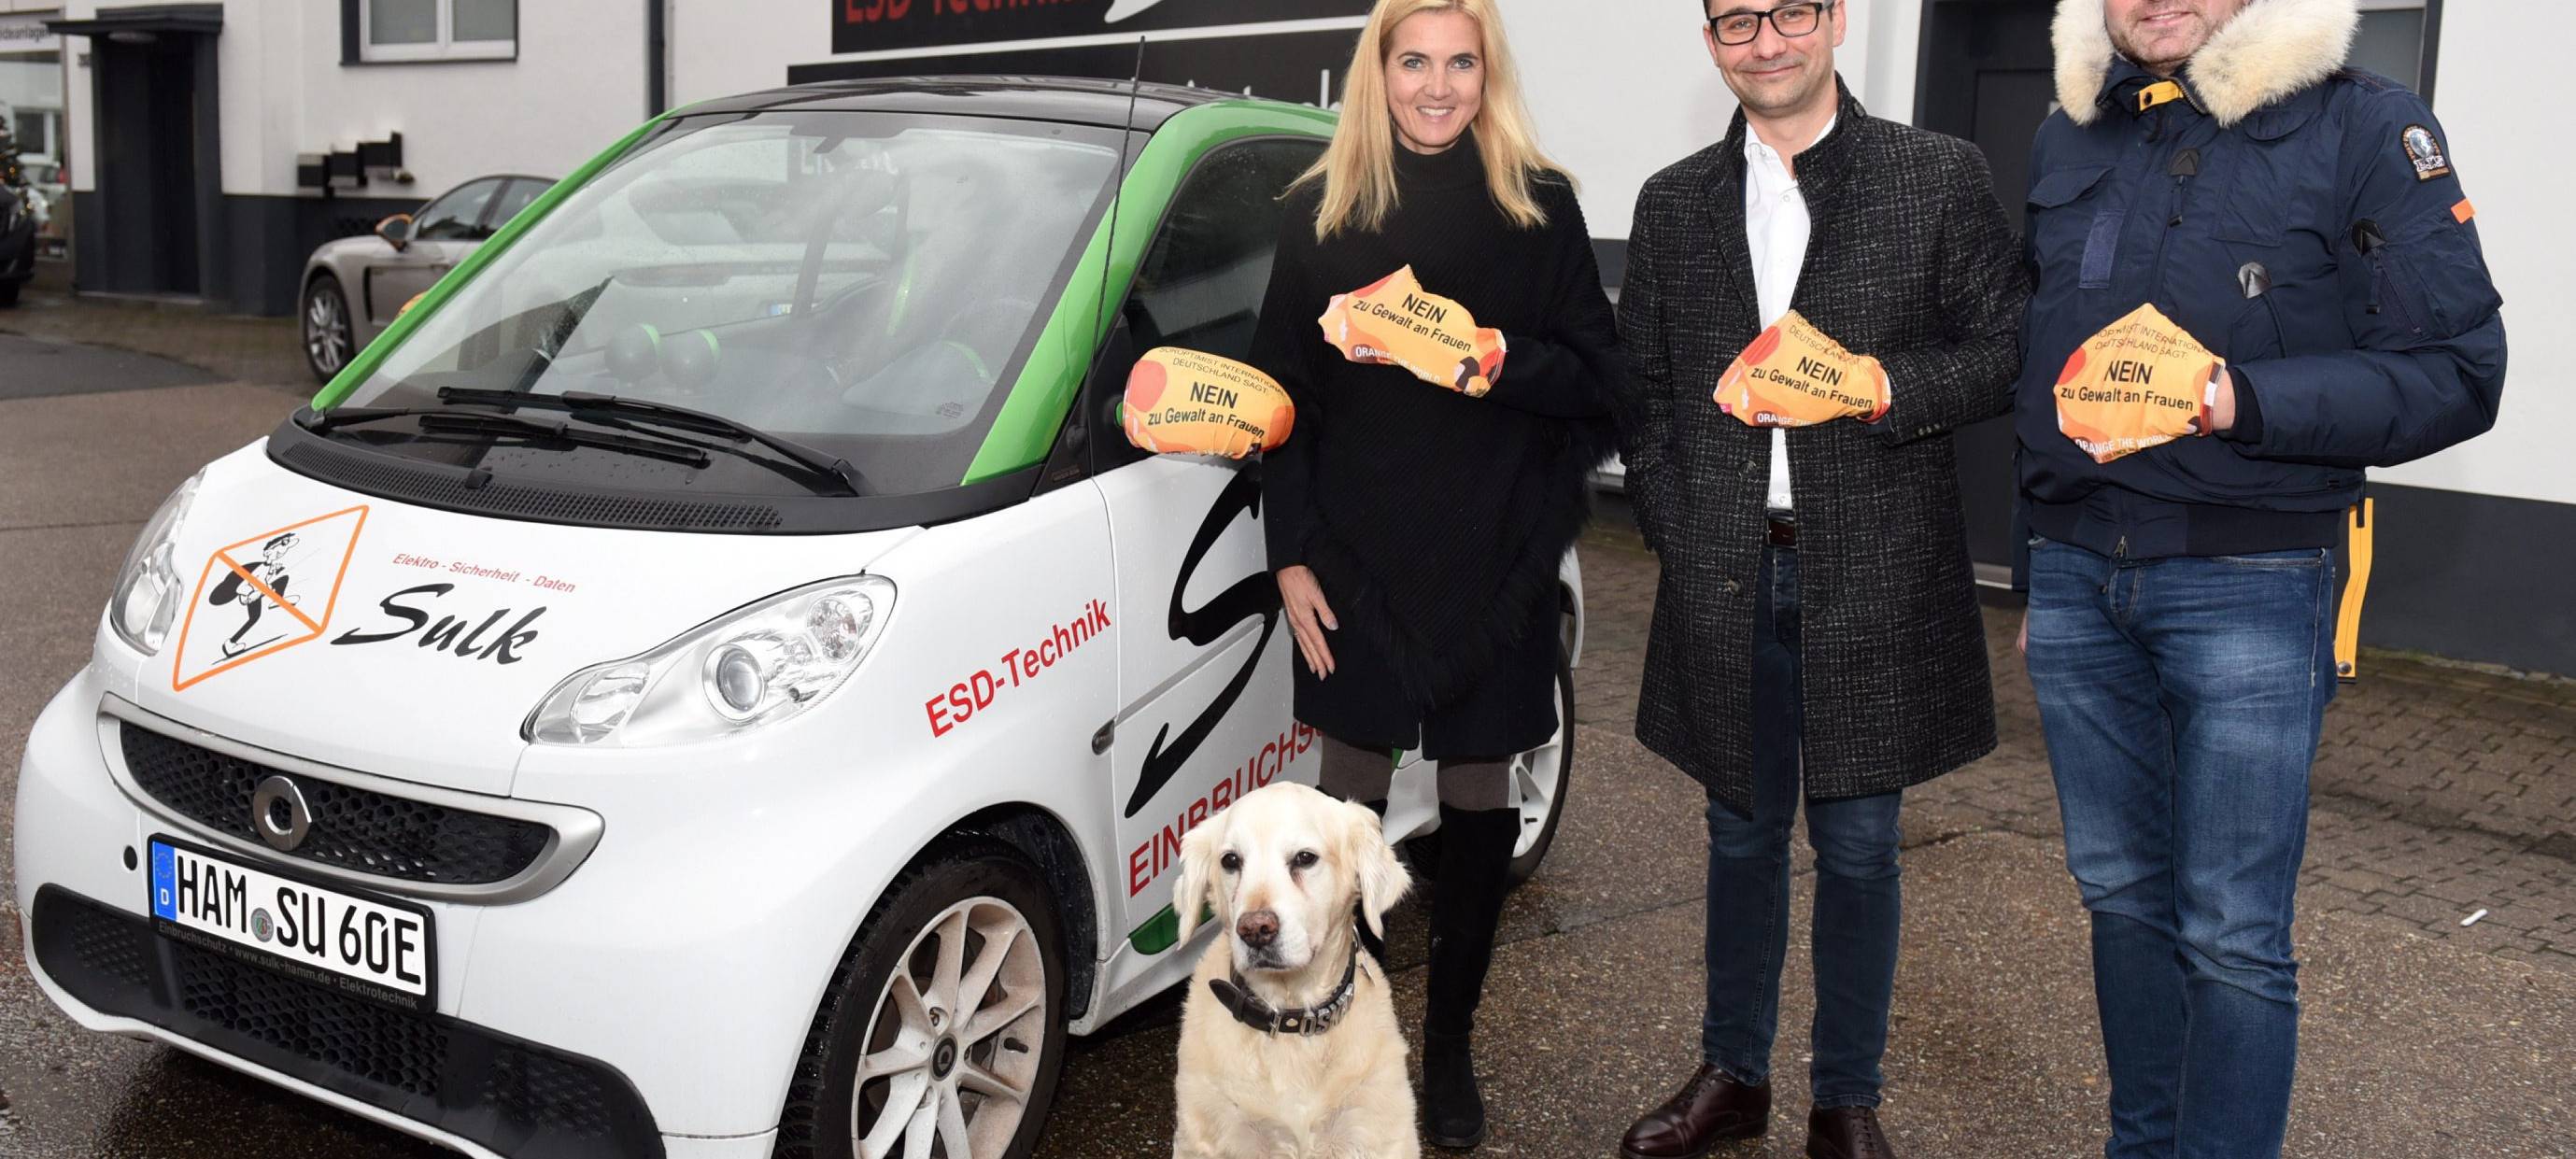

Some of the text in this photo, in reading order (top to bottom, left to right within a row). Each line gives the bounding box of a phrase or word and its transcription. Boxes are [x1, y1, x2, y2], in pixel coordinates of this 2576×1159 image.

[1401, 292, 1448, 324] NEIN
[1352, 299, 1472, 352] zu Gewalt an Frauen
[1173, 357, 1240, 383] DEUTSCHLAND
[1796, 356, 1842, 386] NEIN
[2104, 360, 2153, 385] NEIN
[1190, 381, 1238, 408] NEIN
[1750, 368, 1873, 409] zu Gewalt an Frauen
[2060, 386, 2194, 411] zu Gewalt an Frauen
[1148, 407, 1265, 439] zu Gewalt an Frauen
[392, 553, 439, 570] Elektro
[448, 561, 520, 583] Sicherheit
[533, 575, 576, 593] Daten
[330, 583, 547, 665] Sulk
[925, 598, 1111, 738] ESD-Technik
[161, 888, 170, 906] D
[177, 855, 420, 985] HAM SU 60E
[158, 921, 418, 1010] Einbruchschutz www.sulk-hamm.de Elektrotechnik
